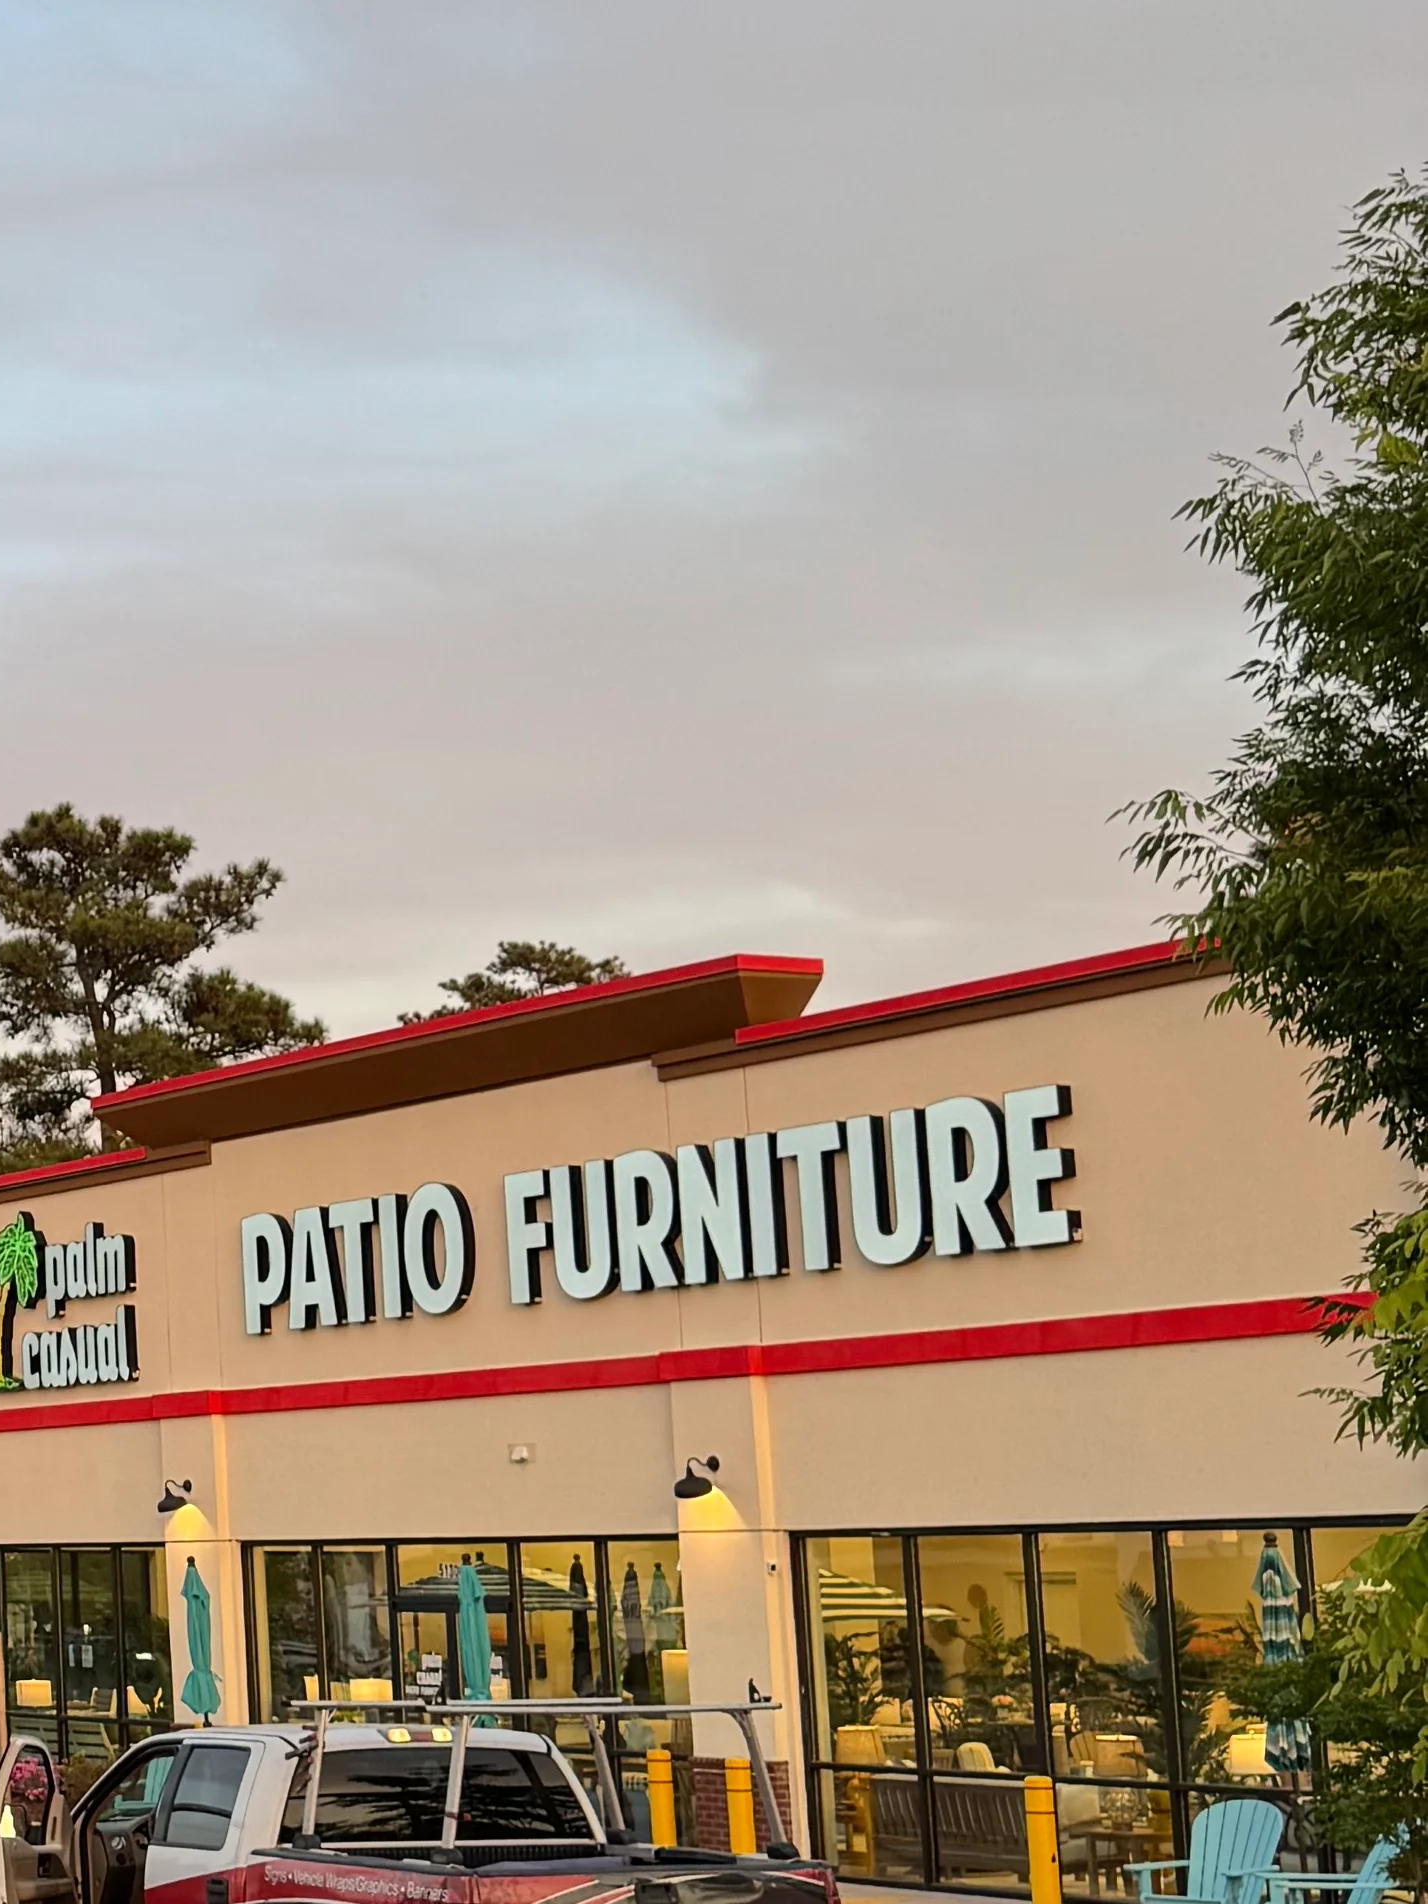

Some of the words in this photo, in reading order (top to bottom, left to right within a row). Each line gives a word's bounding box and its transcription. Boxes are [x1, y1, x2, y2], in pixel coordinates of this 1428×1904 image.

[240, 1181, 473, 1335] PATIO
[502, 1084, 1078, 1305] FURNITURE
[44, 1222, 129, 1319] palm
[21, 1304, 133, 1389] casual
[263, 1864, 289, 1886] Signs
[293, 1869, 325, 1888] Vehicle
[406, 1881, 449, 1902] Banners
